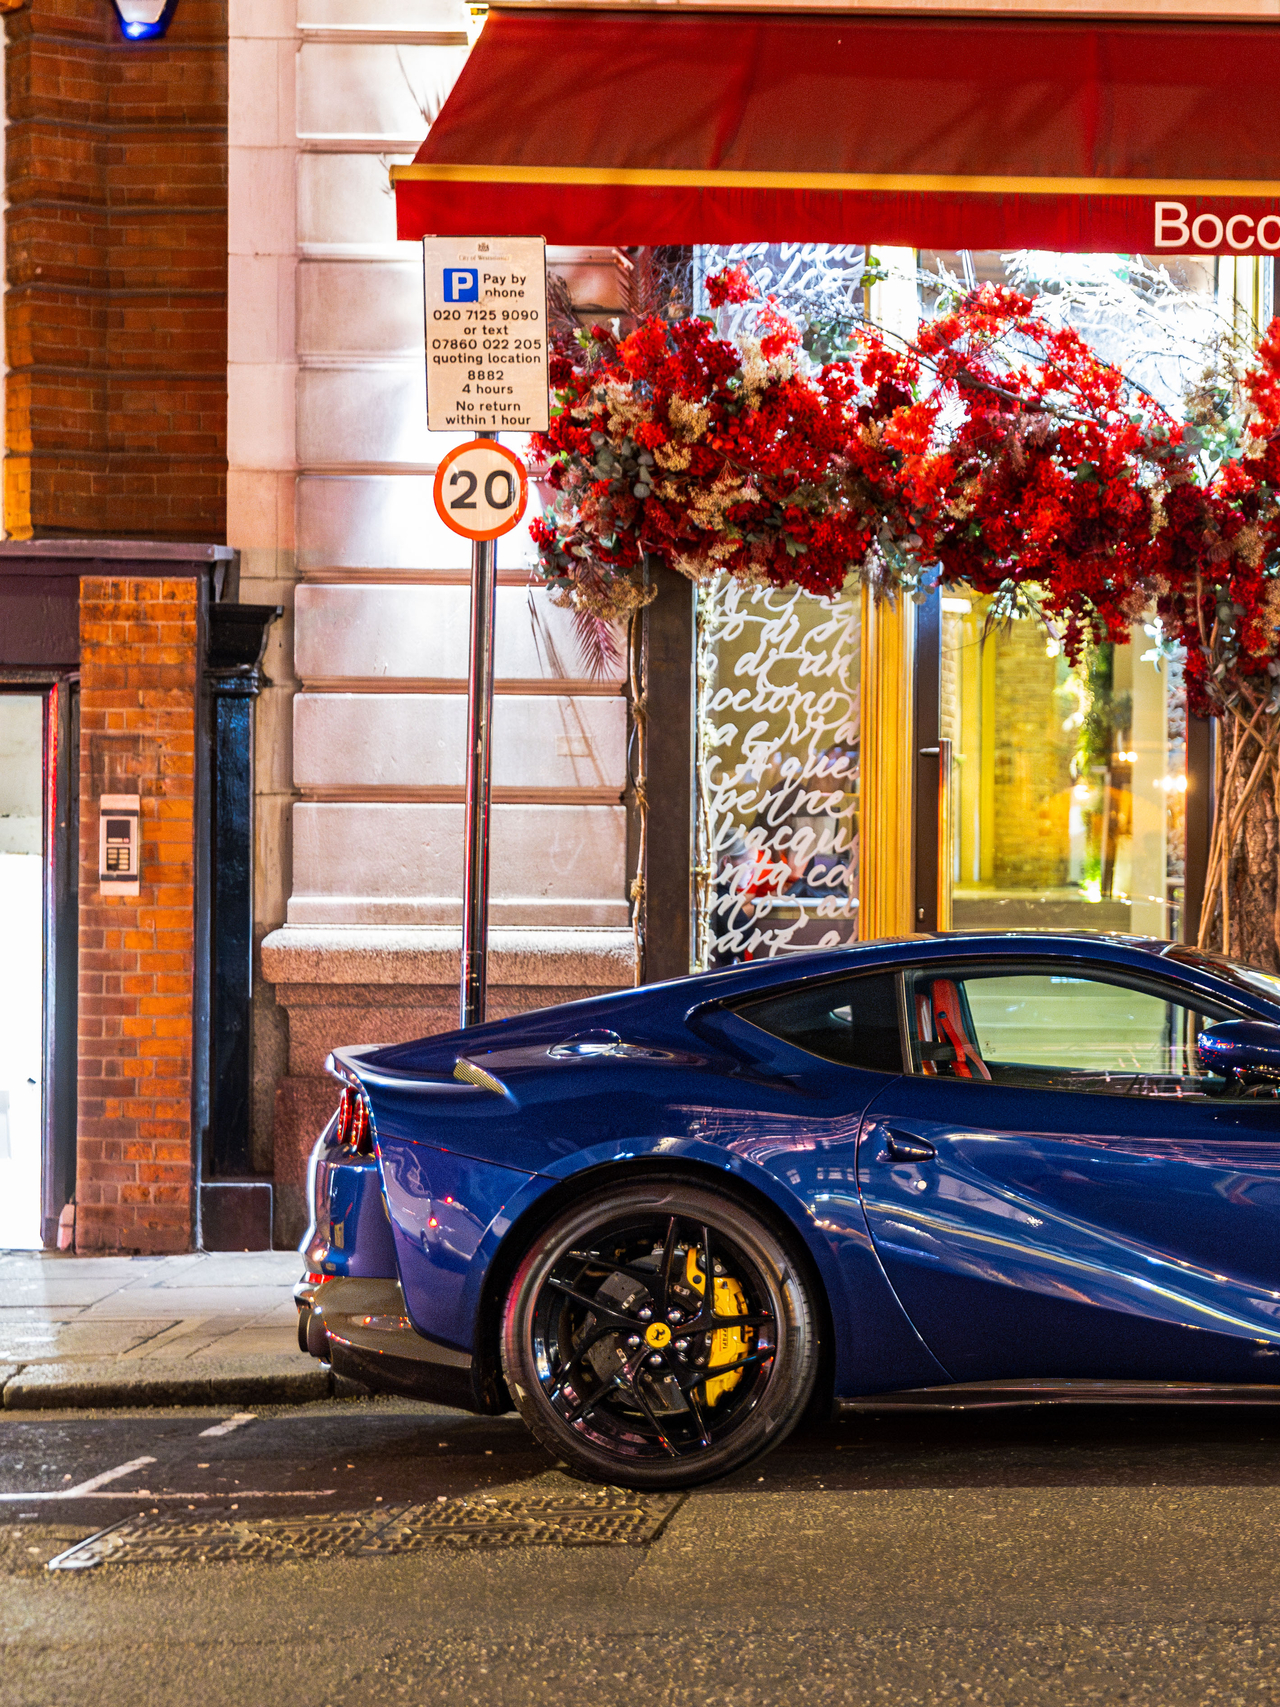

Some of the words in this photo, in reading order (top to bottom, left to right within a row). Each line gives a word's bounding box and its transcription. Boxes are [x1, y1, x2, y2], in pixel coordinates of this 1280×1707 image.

[483, 273, 506, 286] Pay
[511, 273, 526, 286] by
[452, 271, 473, 300] P
[433, 309, 461, 321] 020
[466, 309, 497, 321] 7125
[501, 309, 539, 321] 9090
[464, 326, 477, 335] or
[482, 325, 509, 335] text
[432, 339, 478, 350] 07860
[482, 339, 509, 350] 022
[514, 339, 541, 350] 205
[433, 353, 483, 365] quoting
[488, 353, 541, 363] location
[468, 370, 504, 381] 8882
[462, 383, 471, 394] 4
[476, 383, 513, 394] hours
[456, 401, 474, 411] No
[479, 401, 521, 411] return
[446, 415, 486, 425] within
[491, 415, 496, 425] 1
[502, 415, 531, 425] hour
[449, 470, 515, 509] 20
